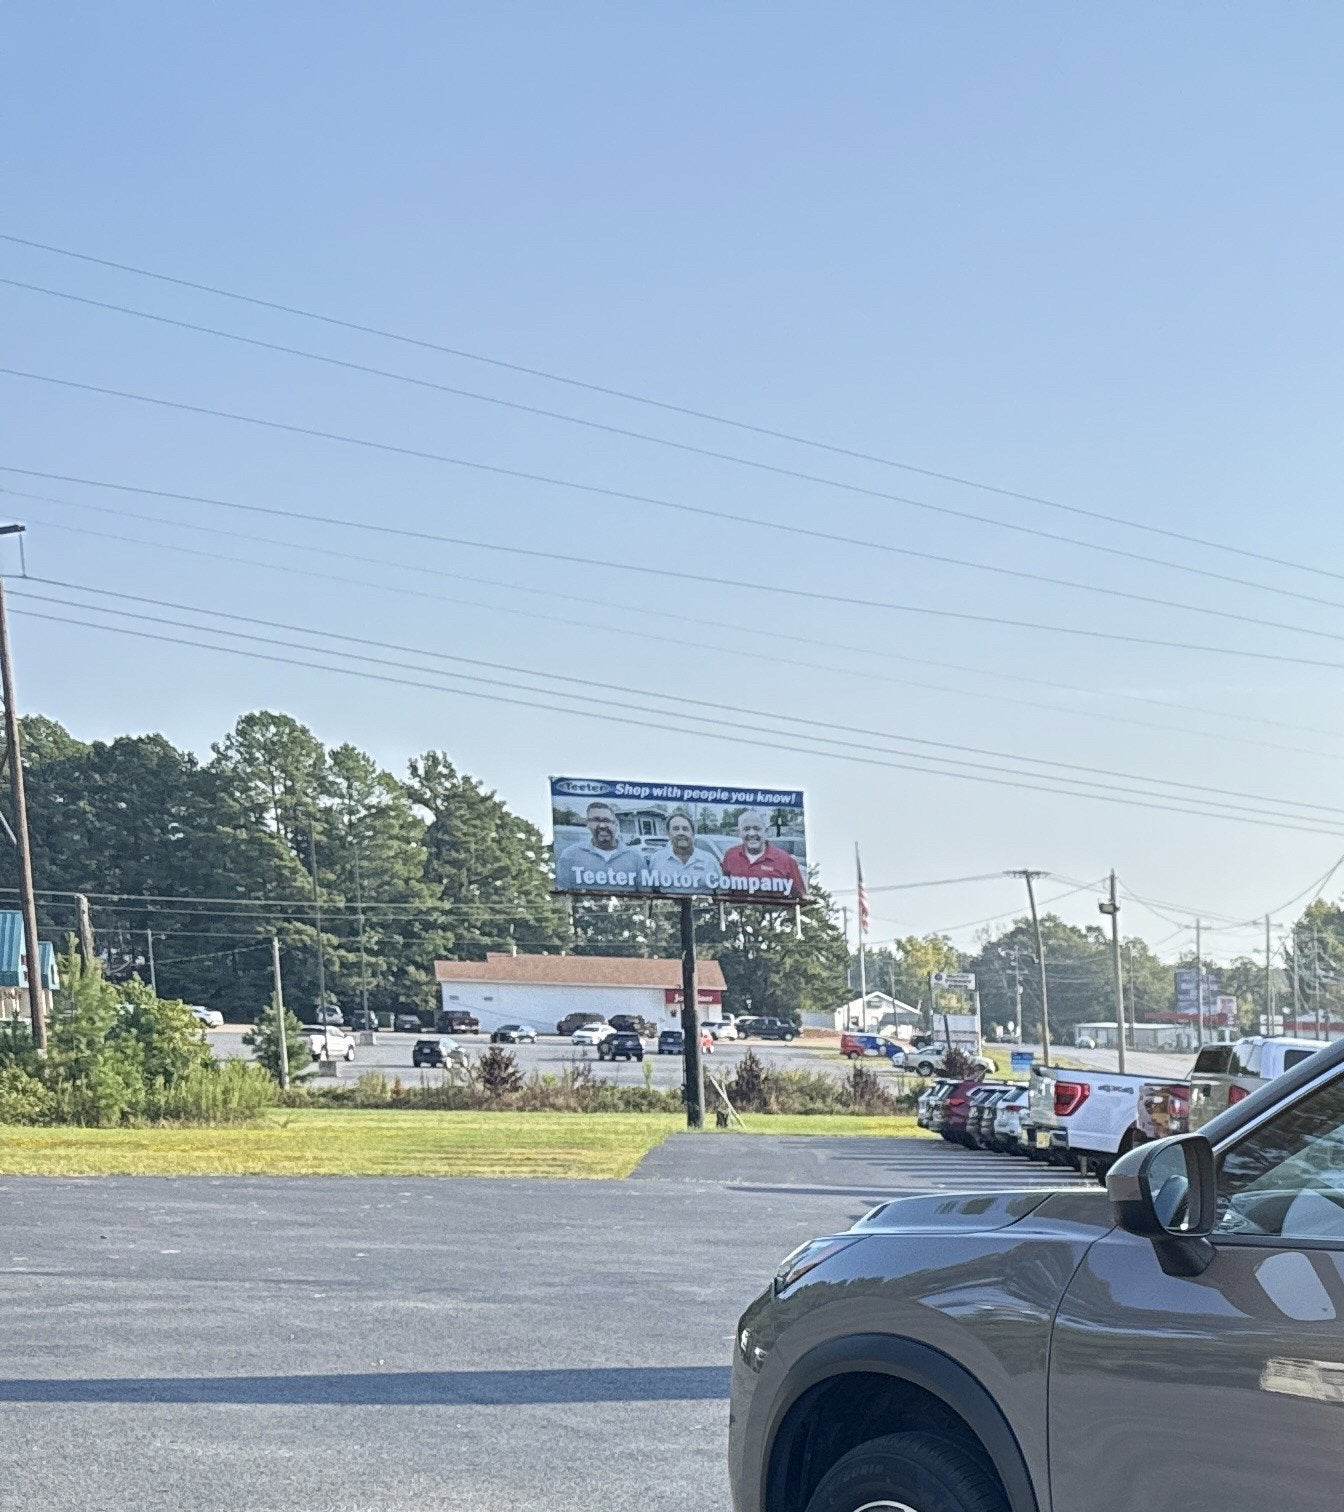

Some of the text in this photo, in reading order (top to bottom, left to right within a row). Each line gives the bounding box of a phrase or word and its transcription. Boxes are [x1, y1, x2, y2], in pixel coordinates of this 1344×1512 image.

[615, 783, 796, 805] Shop with people you know!
[571, 865, 793, 896] Teeter Motor Company
